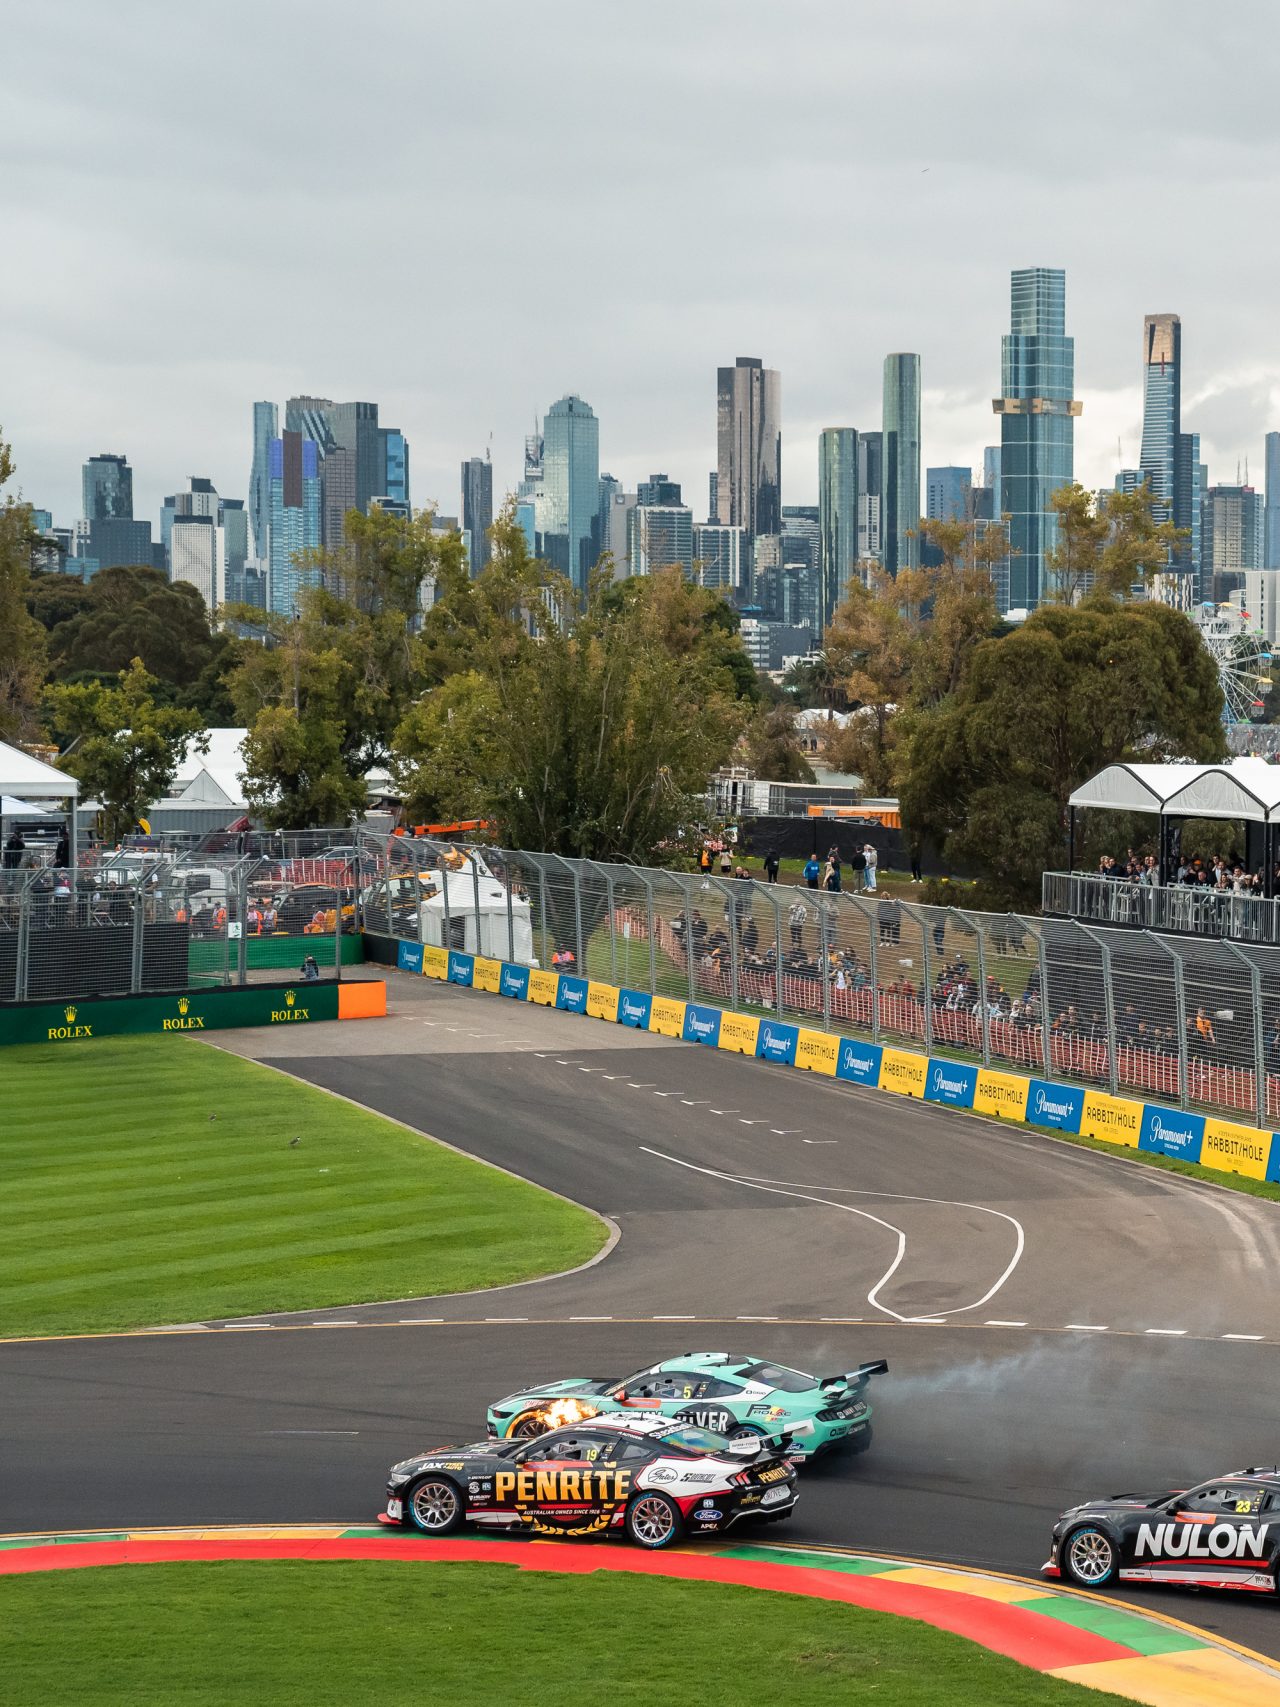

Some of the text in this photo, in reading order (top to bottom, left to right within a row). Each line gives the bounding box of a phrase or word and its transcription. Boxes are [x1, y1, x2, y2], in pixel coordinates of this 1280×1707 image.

[162, 1016, 205, 1030] ROLEX
[271, 1008, 310, 1023] ROLEX
[47, 1025, 93, 1040] ROLEX
[762, 1027, 791, 1052] Paramount+
[844, 1047, 874, 1074] Paramount+
[883, 1062, 923, 1083] RABBIT/HOLE
[933, 1067, 968, 1095] Paramount+
[979, 1083, 1023, 1106] RABBIT/HOLE
[1034, 1088, 1074, 1118] Paramount+
[1086, 1108, 1137, 1130] RABBIT/HOLE
[1149, 1115, 1193, 1148] Paramount+
[1206, 1135, 1264, 1163] RABBIT/HOLE
[683, 1386, 692, 1398] 5
[586, 1449, 599, 1461] 19
[418, 1462, 444, 1471] JAX
[651, 1469, 676, 1483] Gates
[758, 1466, 788, 1484] PENRITE
[495, 1470, 632, 1501] PENRITE
[699, 1511, 718, 1519] Ford
[1235, 1500, 1251, 1513] 23
[1134, 1523, 1270, 1558] NULON
